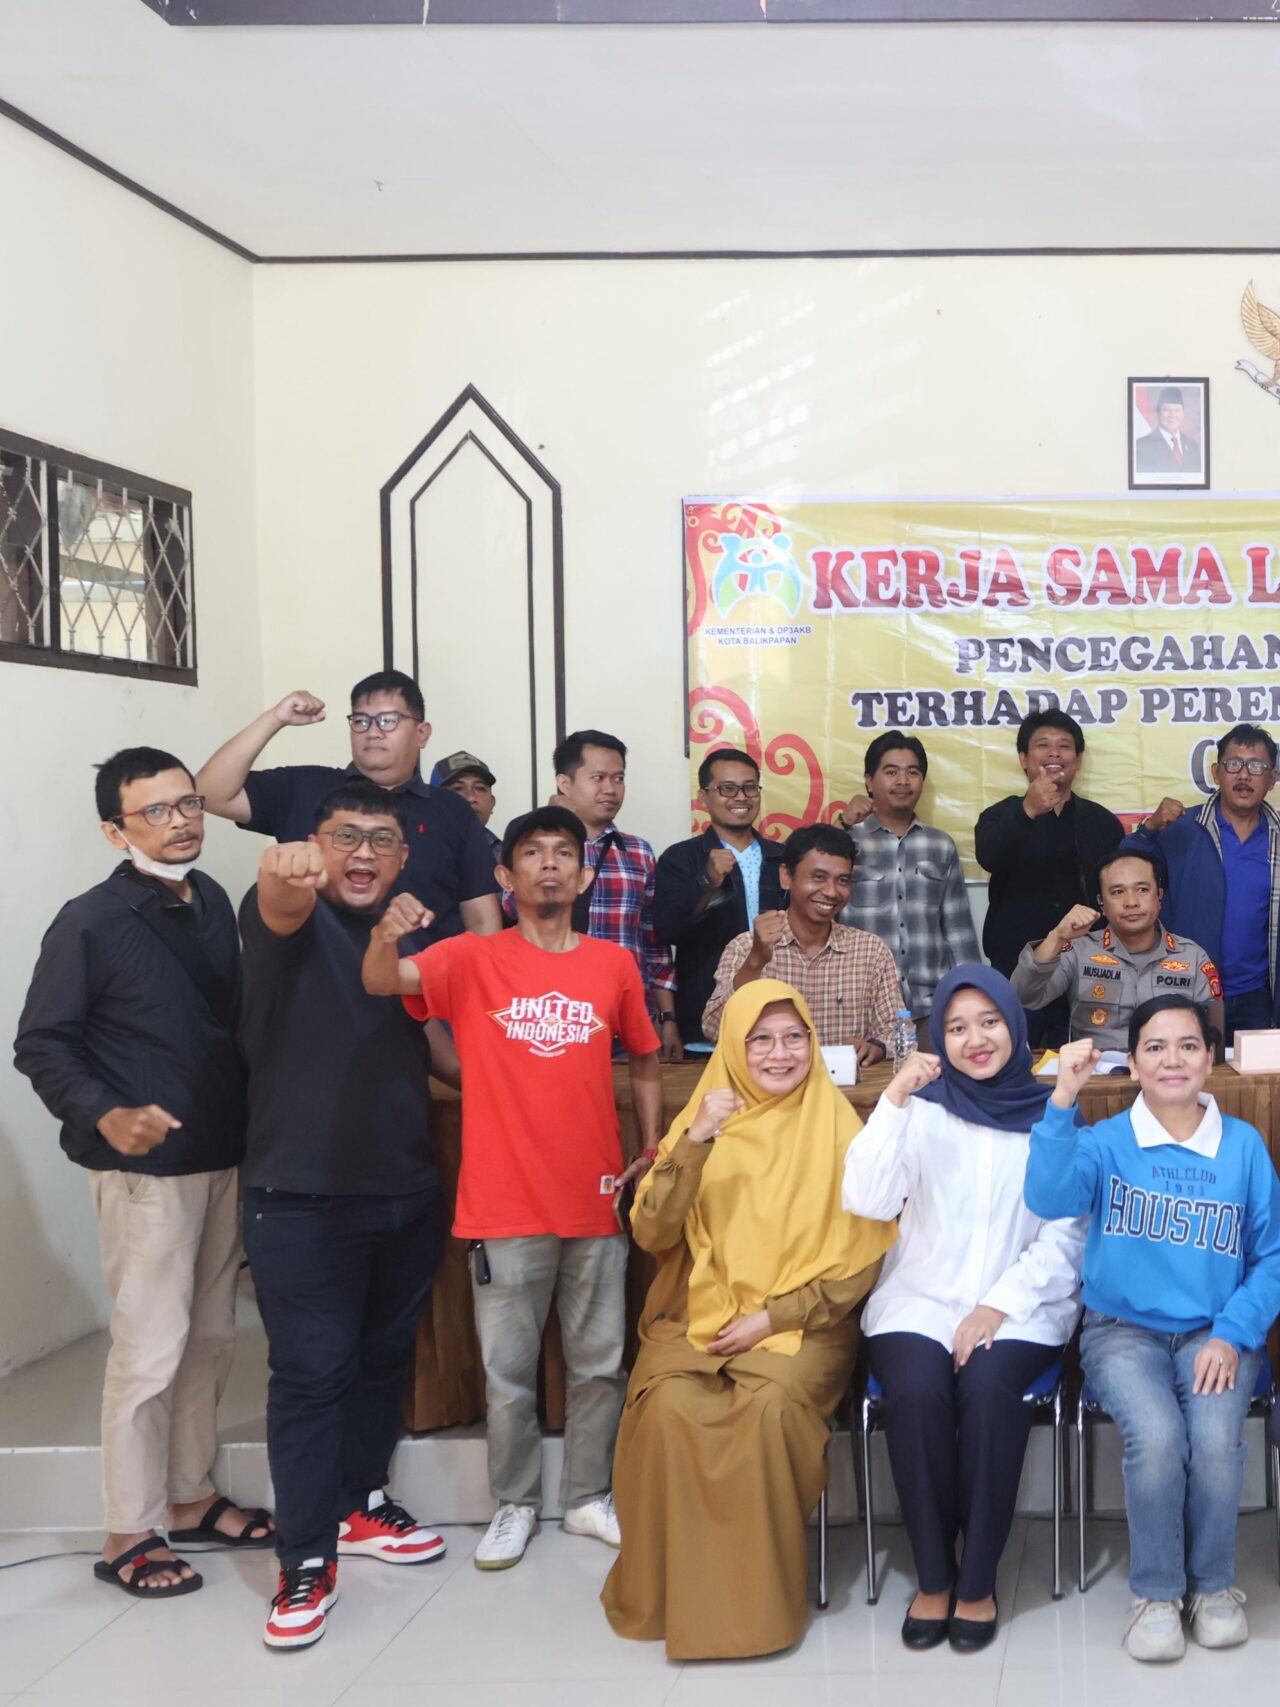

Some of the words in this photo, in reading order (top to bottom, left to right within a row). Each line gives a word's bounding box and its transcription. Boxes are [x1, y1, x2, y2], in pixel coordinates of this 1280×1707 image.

[812, 549, 1031, 609] KERJA
[1046, 546, 1233, 605] SAMA
[705, 627, 766, 635] KEMENTERIAN
[777, 626, 811, 634] DP3AKB
[718, 637, 741, 645] KOTA
[743, 636, 797, 645] BALIKPAPAN
[852, 689, 1127, 727] TERHADAP
[1156, 975, 1191, 987] POLRI
[510, 997, 594, 1024] UNITED
[506, 1020, 590, 1044] INDONESIA
